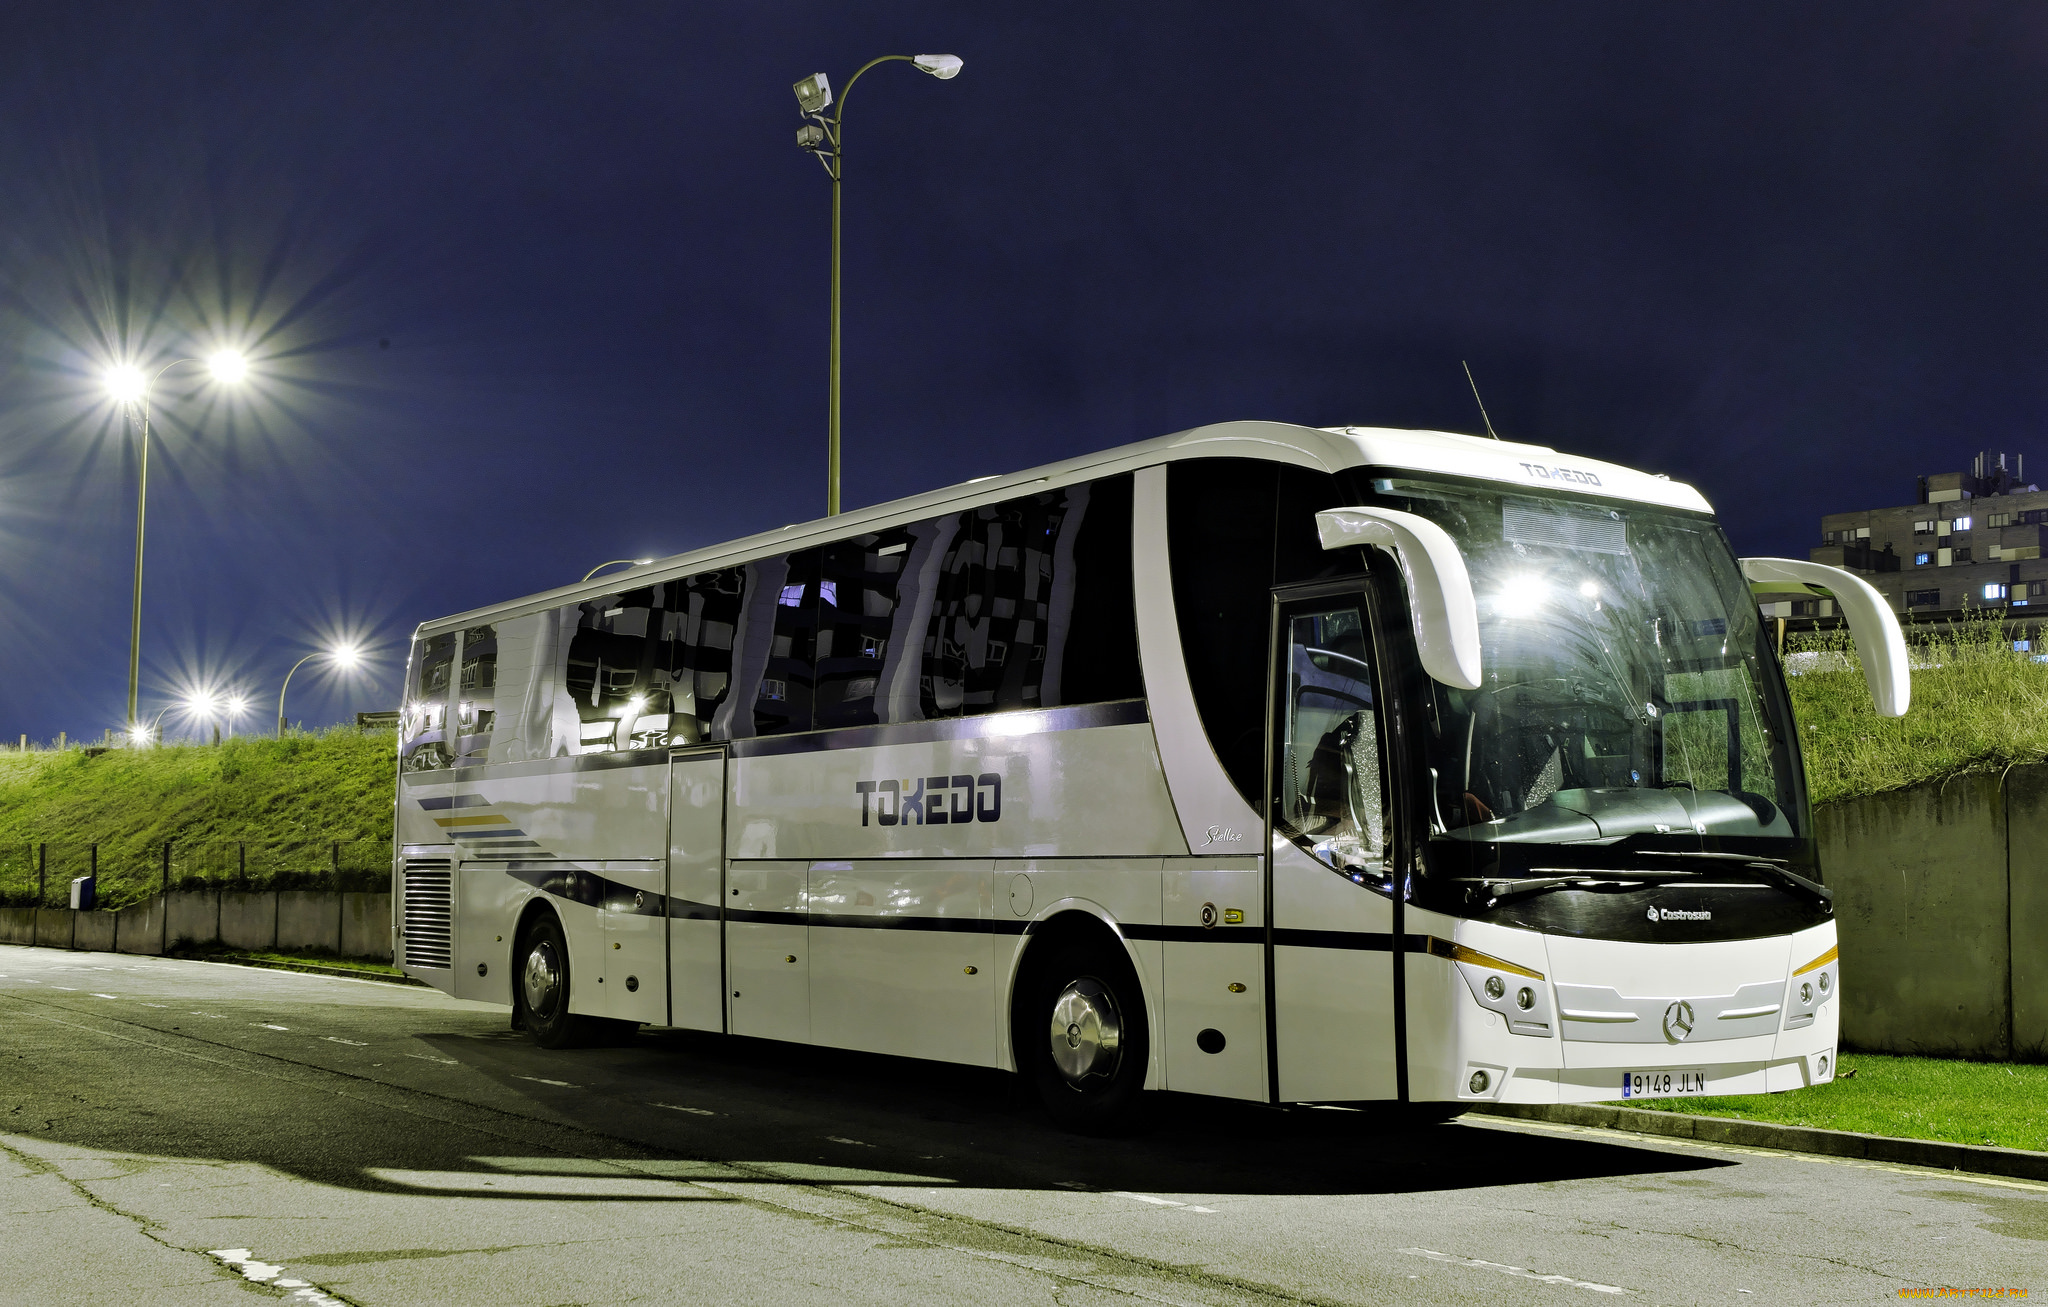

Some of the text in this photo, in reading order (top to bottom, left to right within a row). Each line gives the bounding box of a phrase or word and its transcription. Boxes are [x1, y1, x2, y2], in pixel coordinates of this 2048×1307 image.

[1519, 462, 1602, 487] TOXEDO
[855, 772, 1002, 827] TOXEDO
[1633, 1072, 1704, 1095] 9148 JLN
